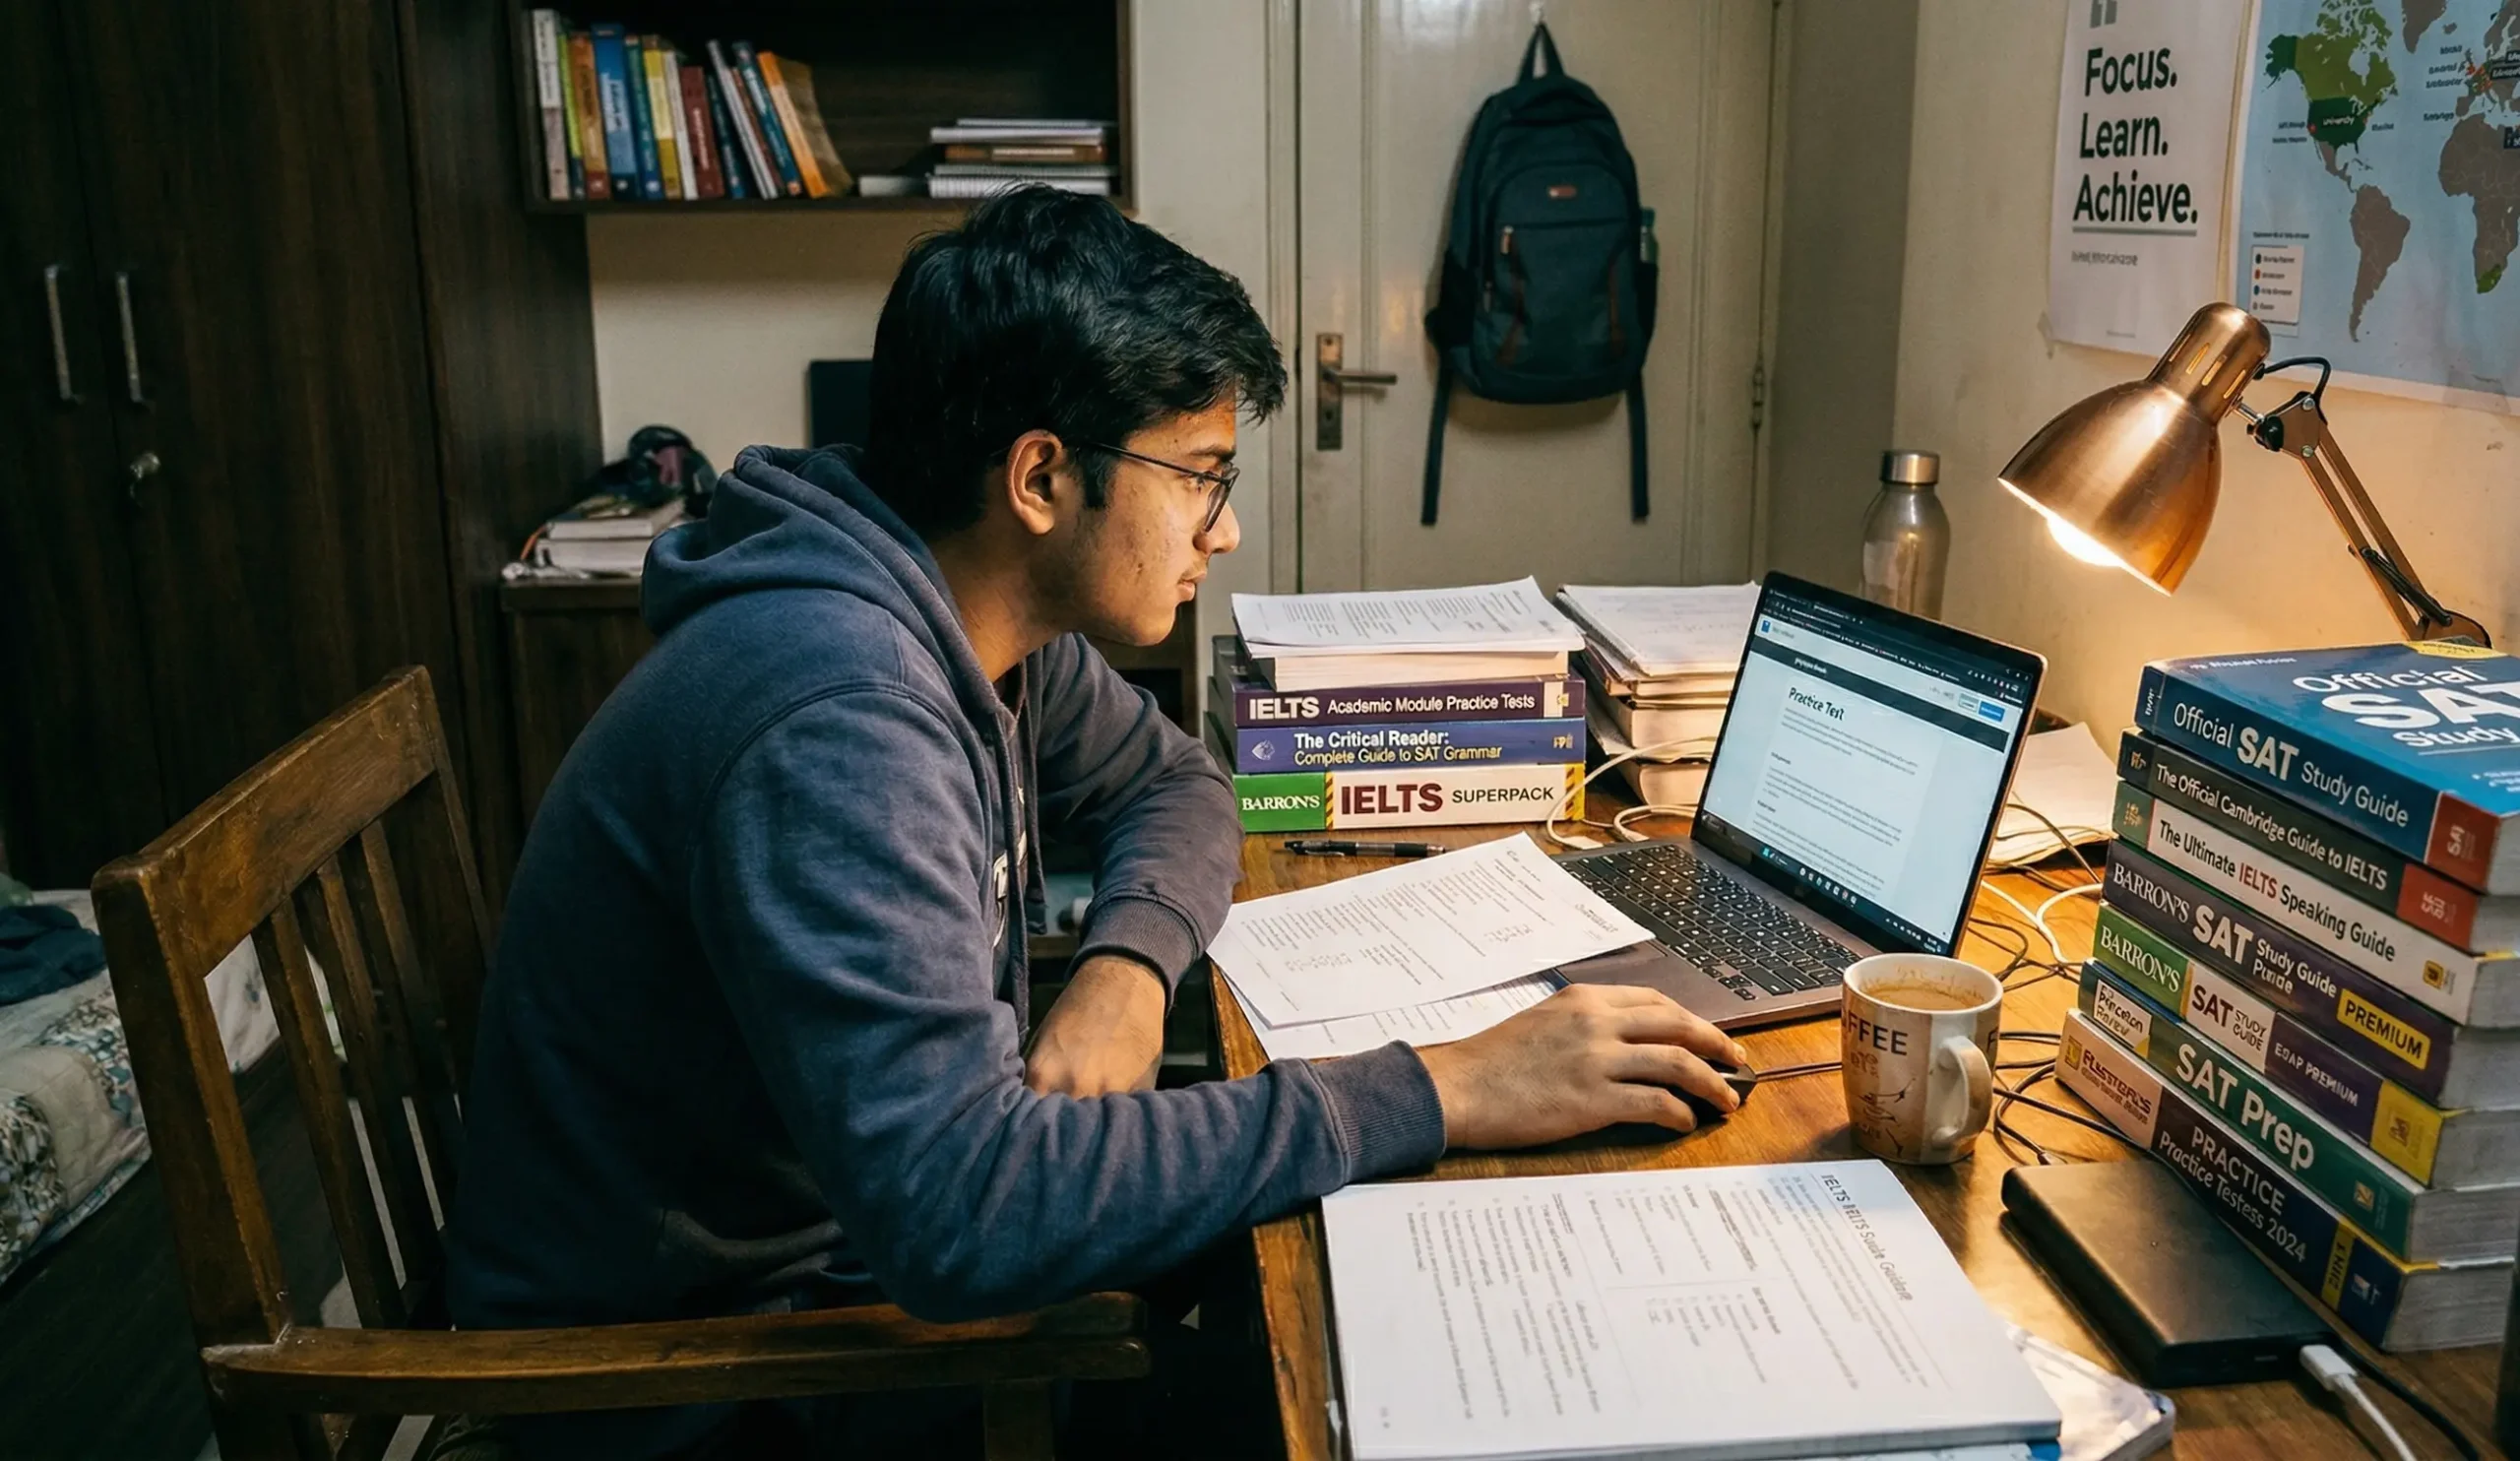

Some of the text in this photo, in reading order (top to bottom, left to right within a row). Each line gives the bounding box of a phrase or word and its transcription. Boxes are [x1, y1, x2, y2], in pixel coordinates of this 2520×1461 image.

[2084, 47, 2177, 96] Focus.
[2079, 112, 2169, 159] Learn.
[2073, 169, 2198, 223] Achieve.
[2293, 665, 2488, 692] Official
[1249, 696, 1320, 720] IELTS
[1395, 696, 1443, 712] Module
[1447, 694, 1498, 711] Practice
[1501, 693, 1536, 709] Tests
[1789, 687, 1845, 721] Practice Test
[1293, 730, 1450, 748] The Critical Reader:
[1294, 745, 1502, 767] Complete Guide to SAT Grammar
[2393, 726, 2520, 747] Study
[2174, 702, 2235, 748] Official
[2237, 727, 2300, 782] SAT
[2301, 761, 2352, 805] Study
[2355, 786, 2409, 827] Guide
[1242, 783, 1554, 815] BARRON'S IELTS SUPERPACK
[2157, 764, 2388, 891] The Official Cambridge Guide to IELTS
[2160, 819, 2396, 962] The Ultimate IELTS Speaking Guide
[2101, 925, 2266, 1037] BARRON'S SAT STUDY
[2113, 862, 2423, 1059] BARRON'S SAT Study Guide PREMIUM
[1842, 1010, 1909, 1056] FFEE
[2233, 1023, 2263, 1051] GUIDE
[2175, 1043, 2238, 1111] SAT
[2240, 1088, 2315, 1172] Prep
[1821, 1174, 1851, 1203] IELTS
[2191, 1125, 2286, 1216] PRACTICE
[2159, 1130, 2306, 1263] Practice Testess 2024
